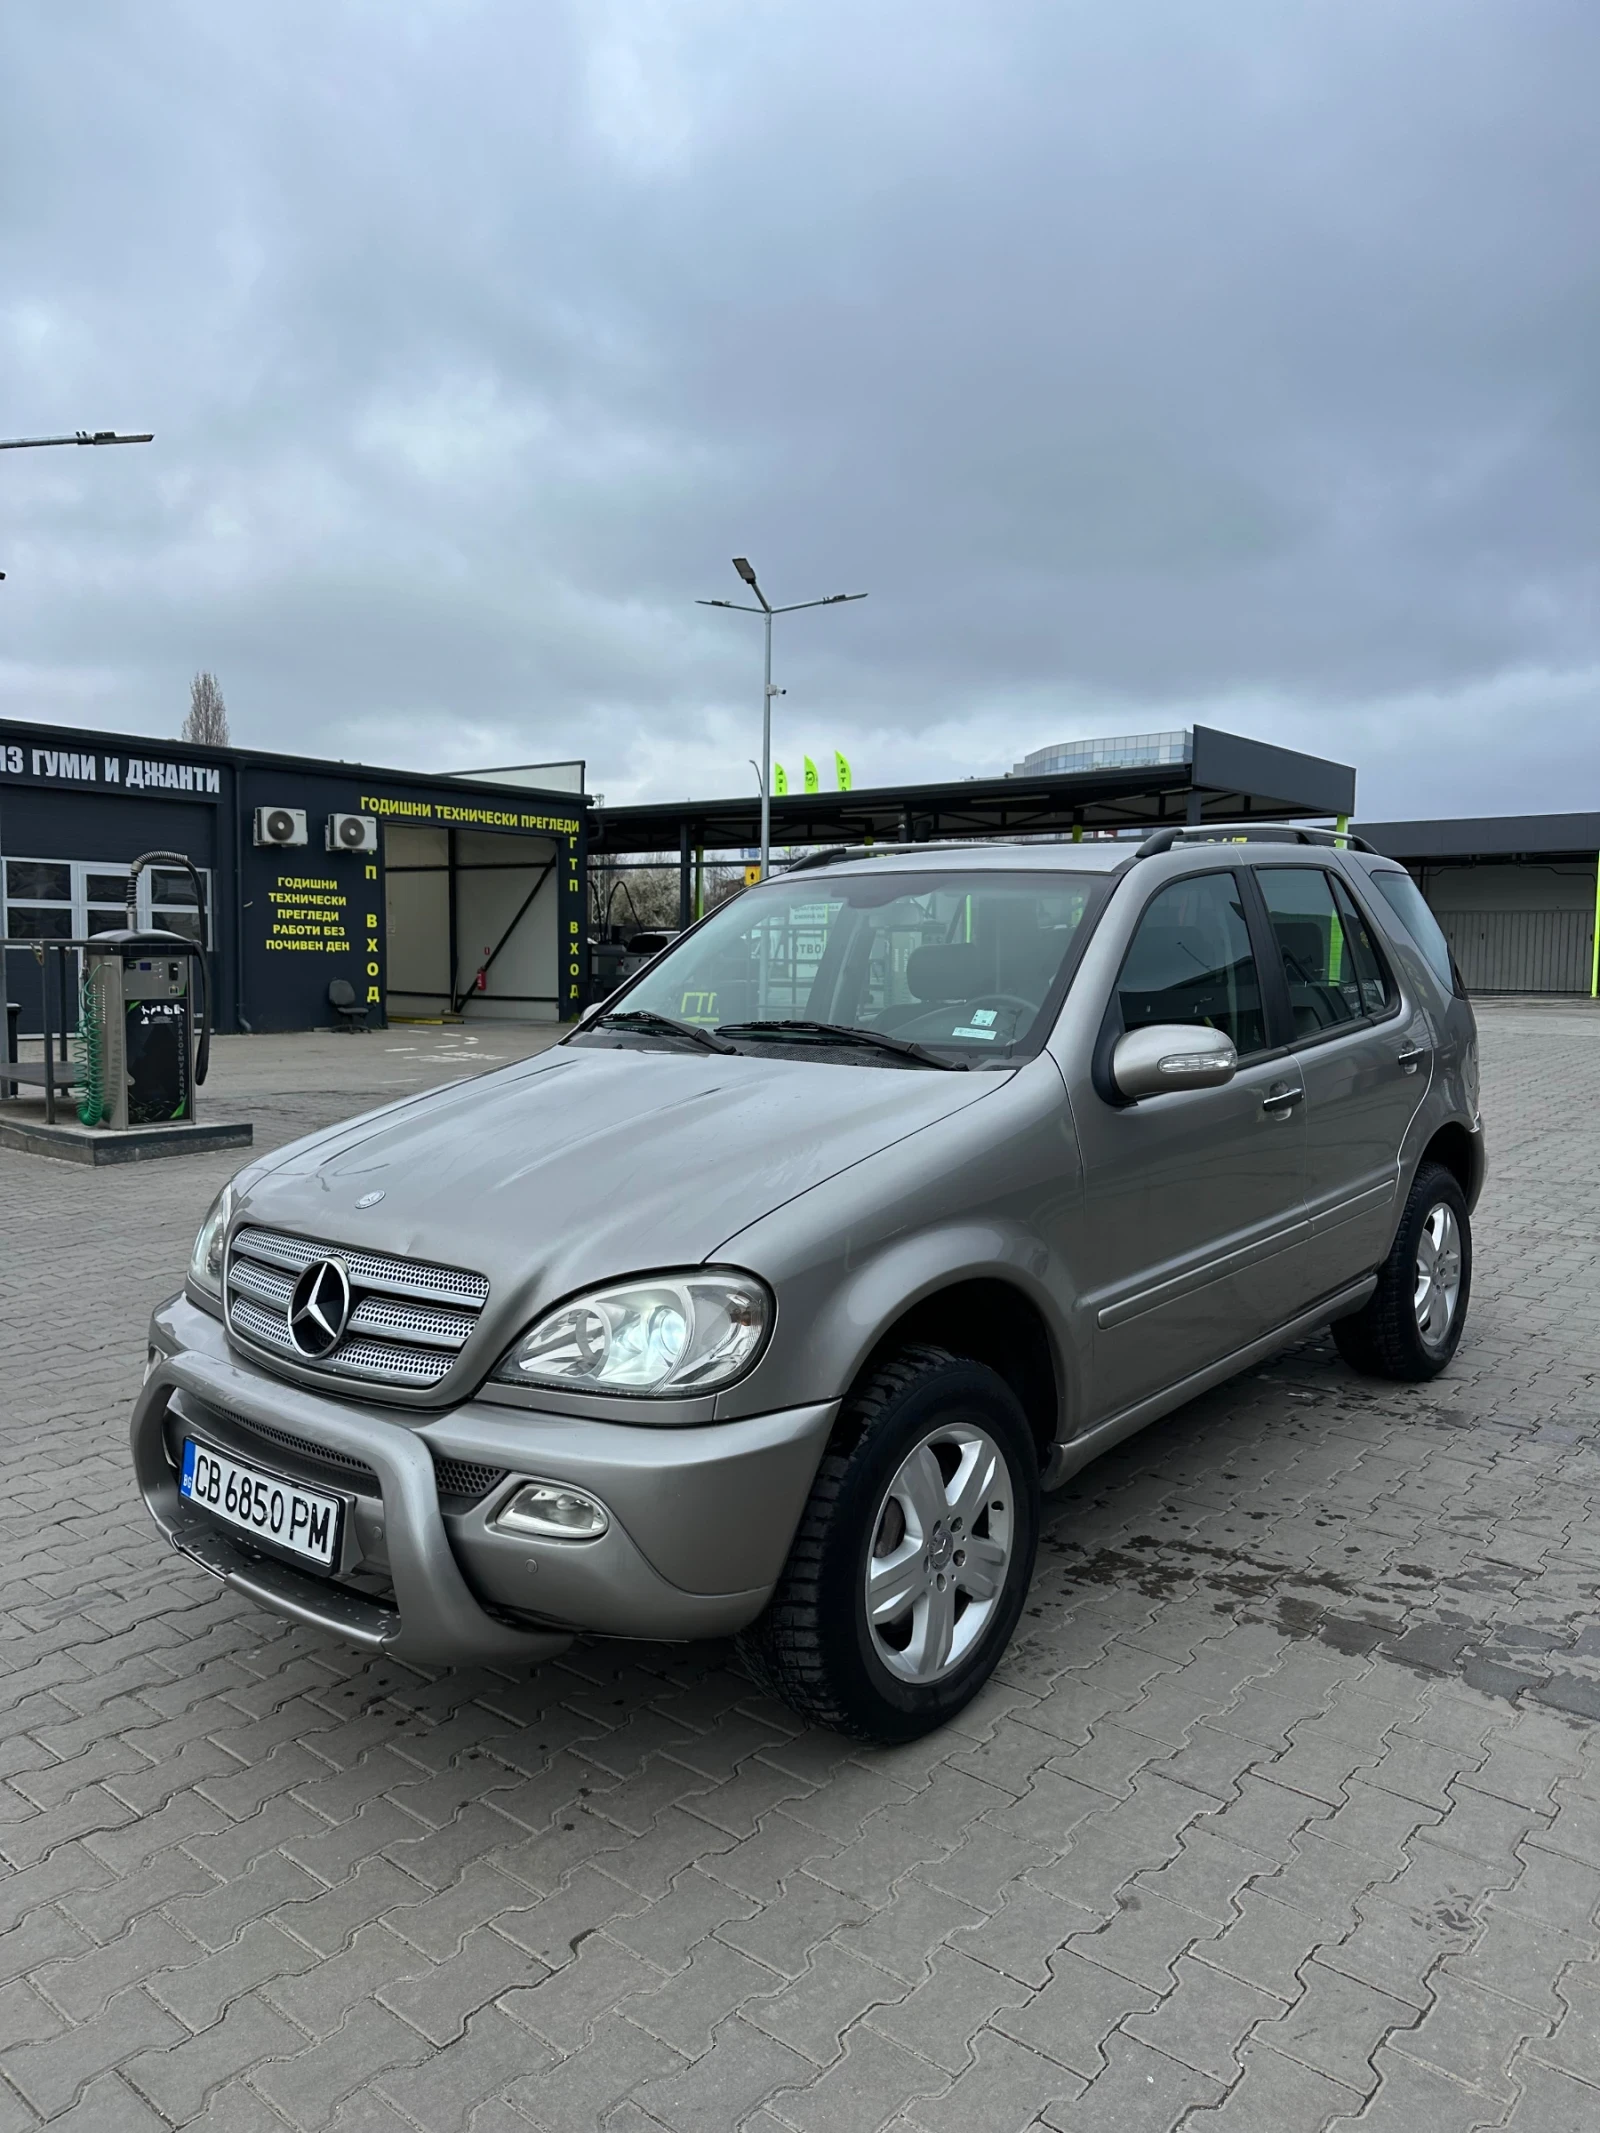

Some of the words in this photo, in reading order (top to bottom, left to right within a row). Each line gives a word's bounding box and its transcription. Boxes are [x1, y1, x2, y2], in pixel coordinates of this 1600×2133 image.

[32, 749, 96, 781] ГУМИ
[104, 757, 120, 783] И
[125, 759, 220, 794] ДЖАНТИ
[361, 796, 432, 817] ГОДИШНИ
[435, 805, 518, 827] ТЕХНИЧЕСКИ
[521, 815, 580, 834] ПРЕГЛЕДИ
[569, 837, 578, 891] ГТП
[277, 877, 338, 890] ГОДИШНИ
[268, 892, 347, 906] ТЕХНИЧЕСКИ
[277, 909, 339, 922] ПРЕГЛЕДИ
[272, 924, 321, 936] РАБОТИ
[323, 926, 345, 937] БЕЗ
[266, 939, 324, 951] ПОЧИВЕН
[326, 941, 350, 952] ДЕН
[366, 913, 380, 1003] ВХОД
[570, 921, 579, 999] ВХОД
[183, 1473, 192, 1489] BG
[195, 1453, 221, 1505] CB
[225, 1470, 284, 1534] 6850
[289, 1496, 331, 1554] PM
